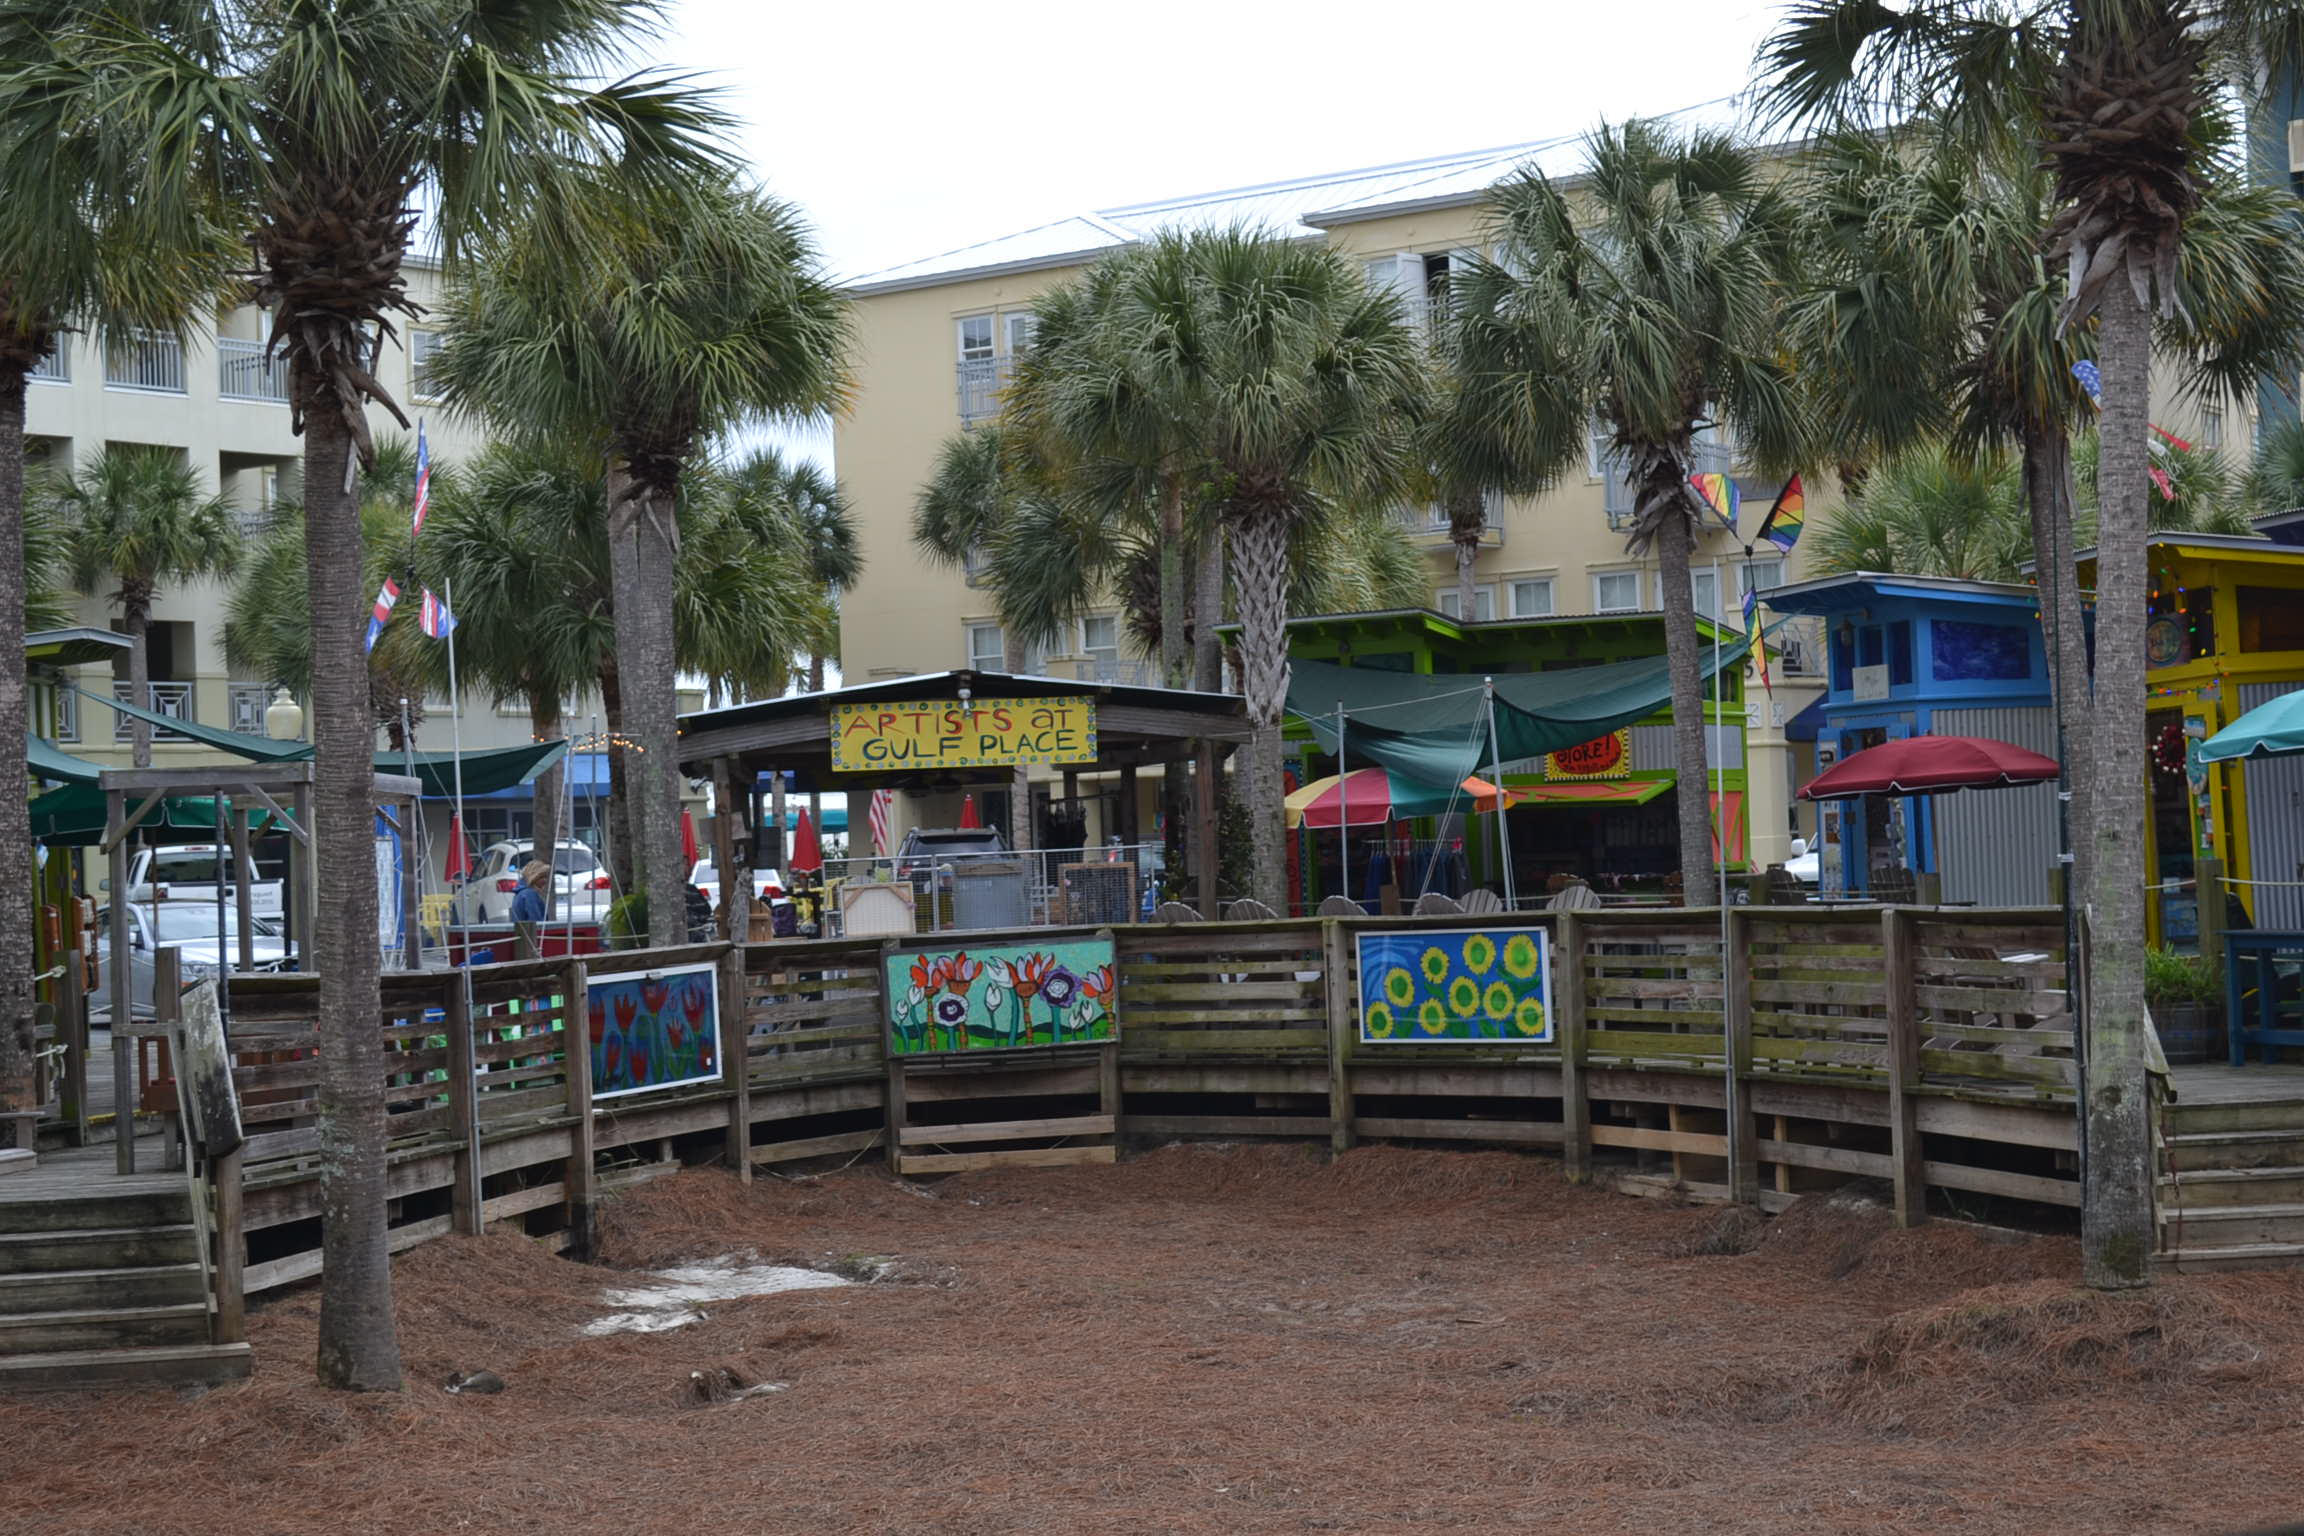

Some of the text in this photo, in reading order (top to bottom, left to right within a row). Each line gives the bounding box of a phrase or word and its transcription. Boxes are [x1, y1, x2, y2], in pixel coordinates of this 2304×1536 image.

[844, 708, 1013, 738] ARTISTS
[862, 729, 1079, 761] GULF PLACE
